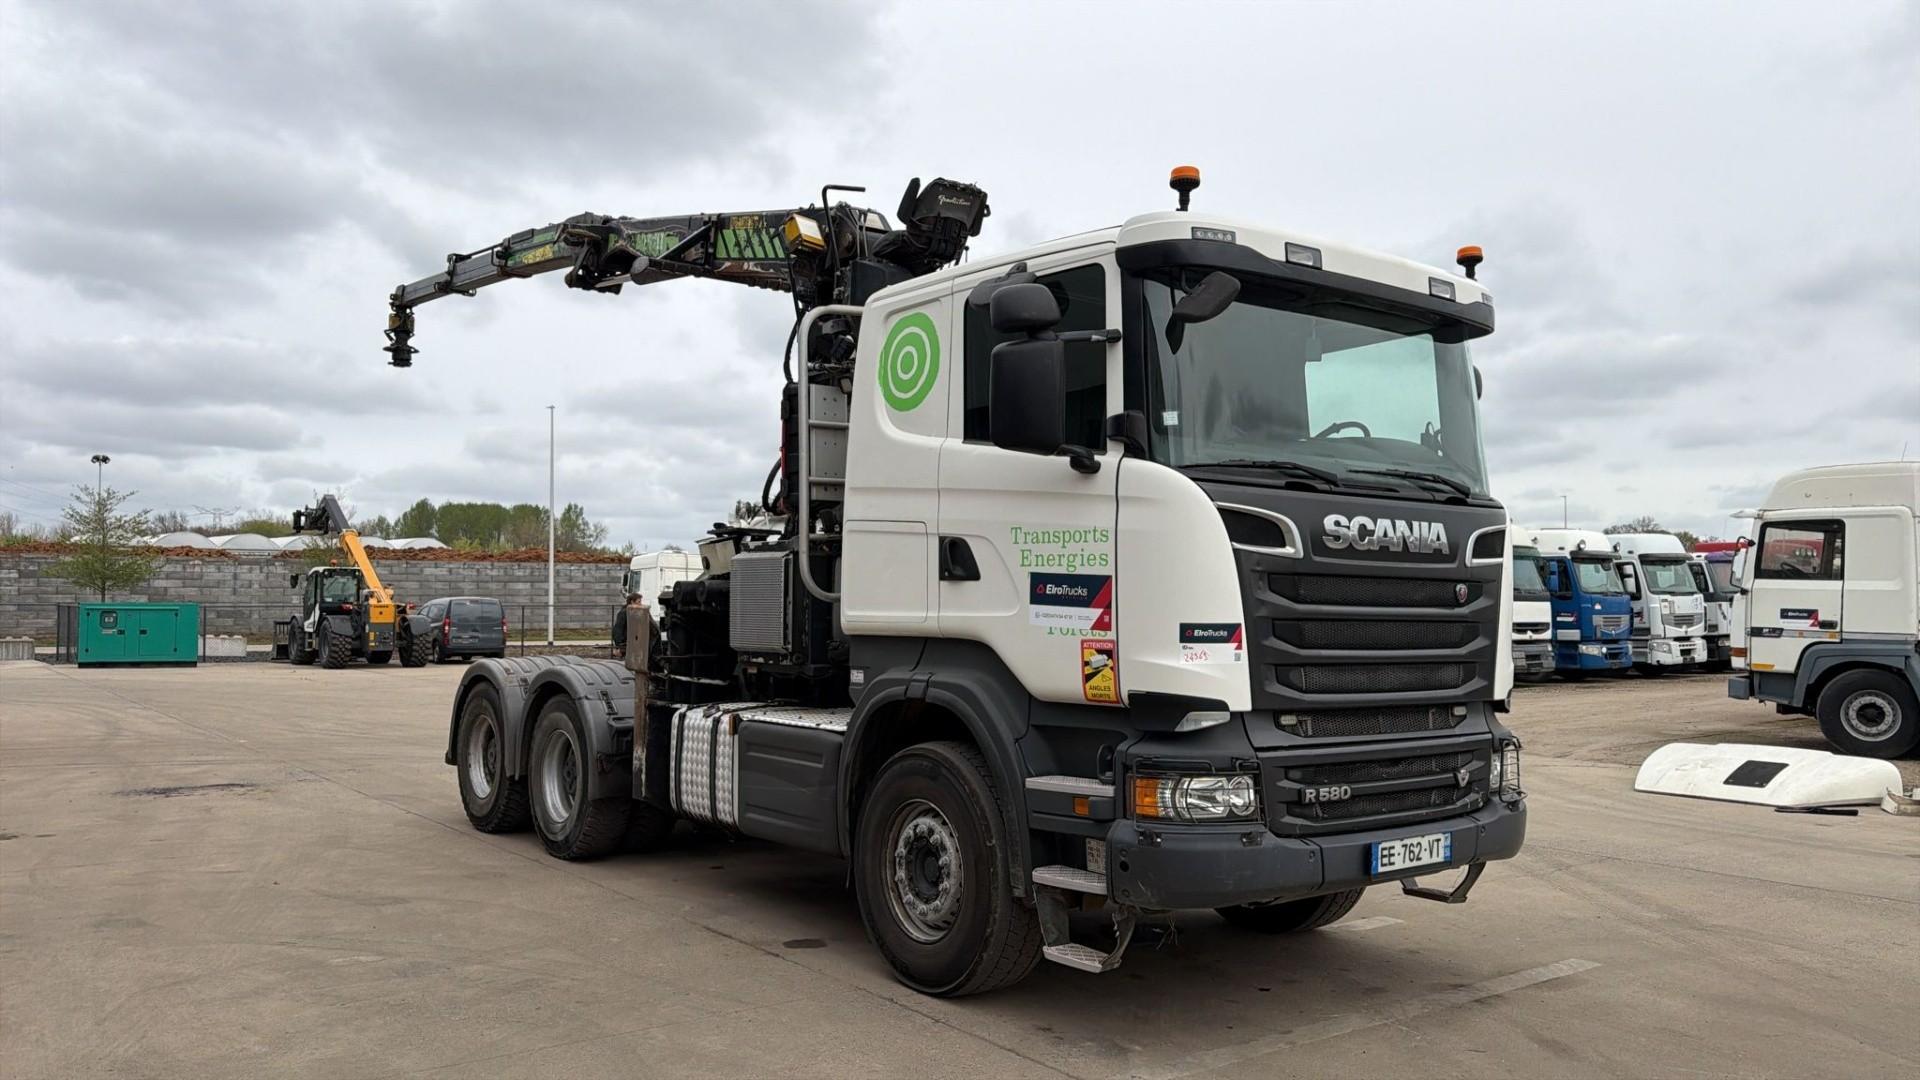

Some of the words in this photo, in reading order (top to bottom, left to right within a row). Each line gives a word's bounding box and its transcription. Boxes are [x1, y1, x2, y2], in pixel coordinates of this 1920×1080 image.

[1010, 525, 1109, 549] Transports
[1322, 514, 1450, 555] SCANIA
[1020, 548, 1109, 573] Energies
[1045, 583, 1088, 597] ElroTrucks
[1193, 629, 1228, 637] ElroTrucks
[1089, 684, 1112, 692] ANGLES
[1305, 789, 1316, 803] R
[1319, 786, 1351, 801] 580
[1380, 838, 1442, 867] EE-762-VT
